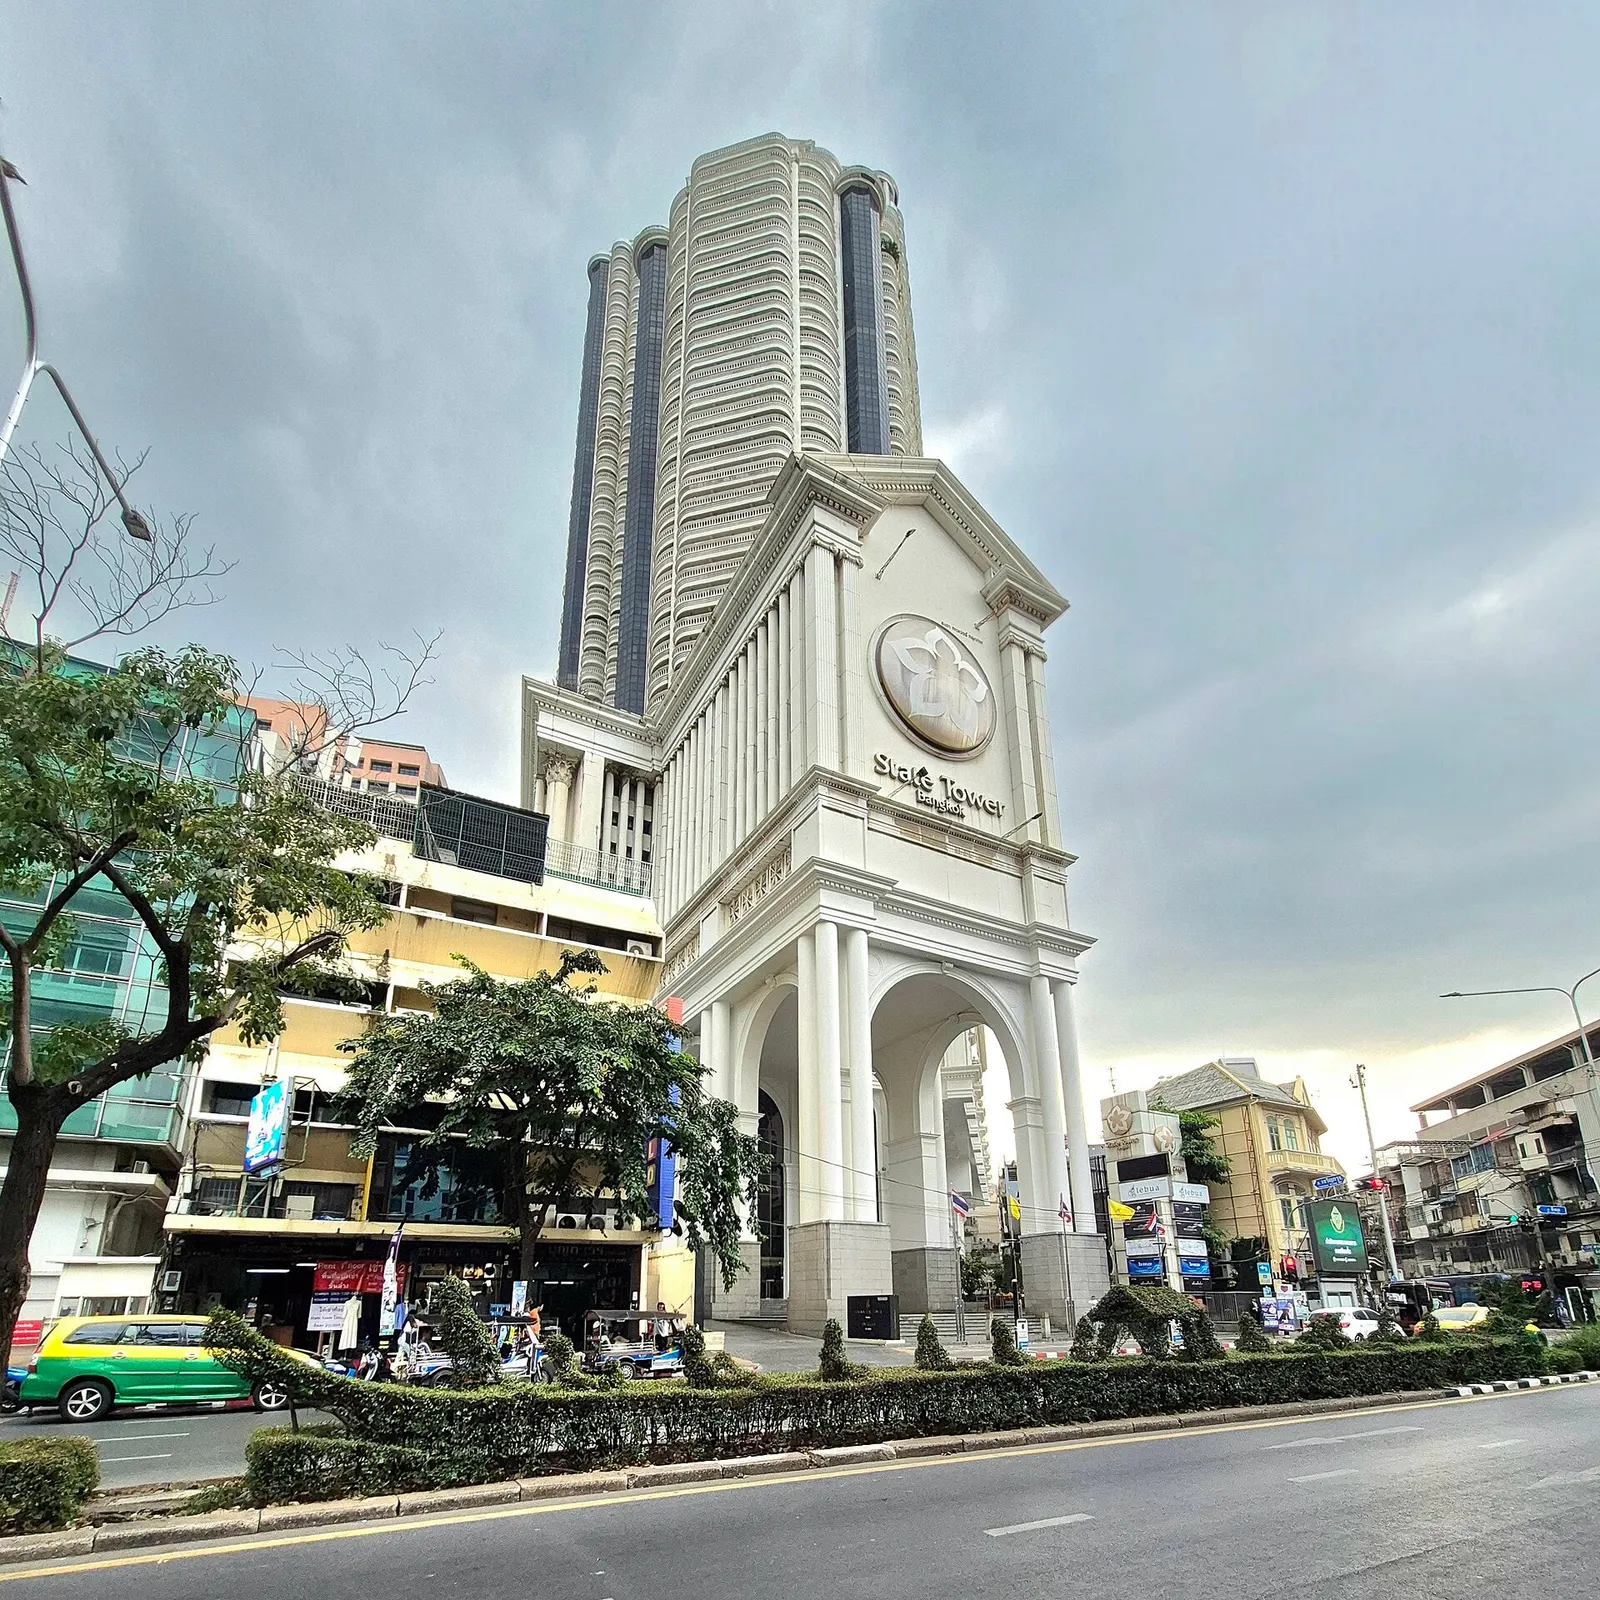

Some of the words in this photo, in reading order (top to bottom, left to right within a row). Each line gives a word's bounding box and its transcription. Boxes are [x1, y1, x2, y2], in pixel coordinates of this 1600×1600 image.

[873, 752, 934, 792] State
[939, 774, 1006, 818] Tower
[915, 788, 966, 818] Bangkok
[1136, 1185, 1160, 1194] lebua
